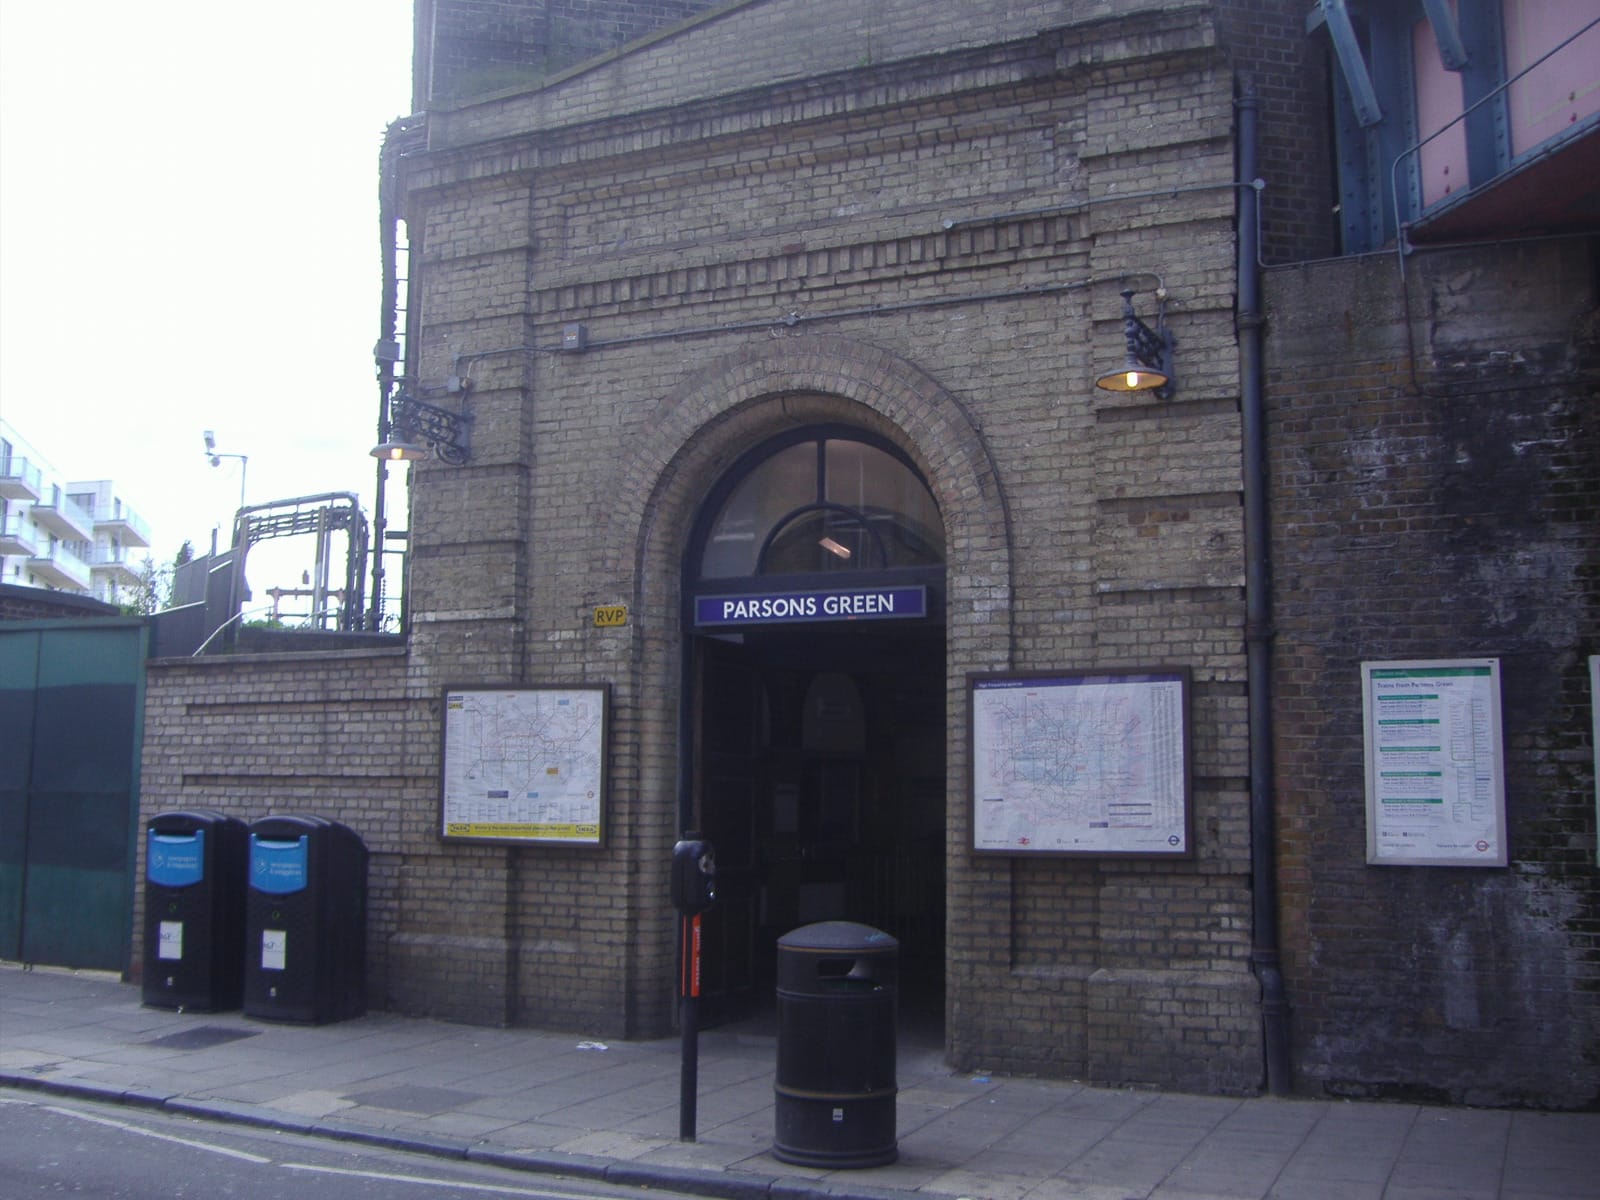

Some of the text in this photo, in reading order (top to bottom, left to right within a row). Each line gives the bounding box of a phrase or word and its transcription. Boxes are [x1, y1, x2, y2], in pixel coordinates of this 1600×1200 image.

[597, 609, 624, 623] RVP
[723, 593, 894, 619] PARSONS GREEN
